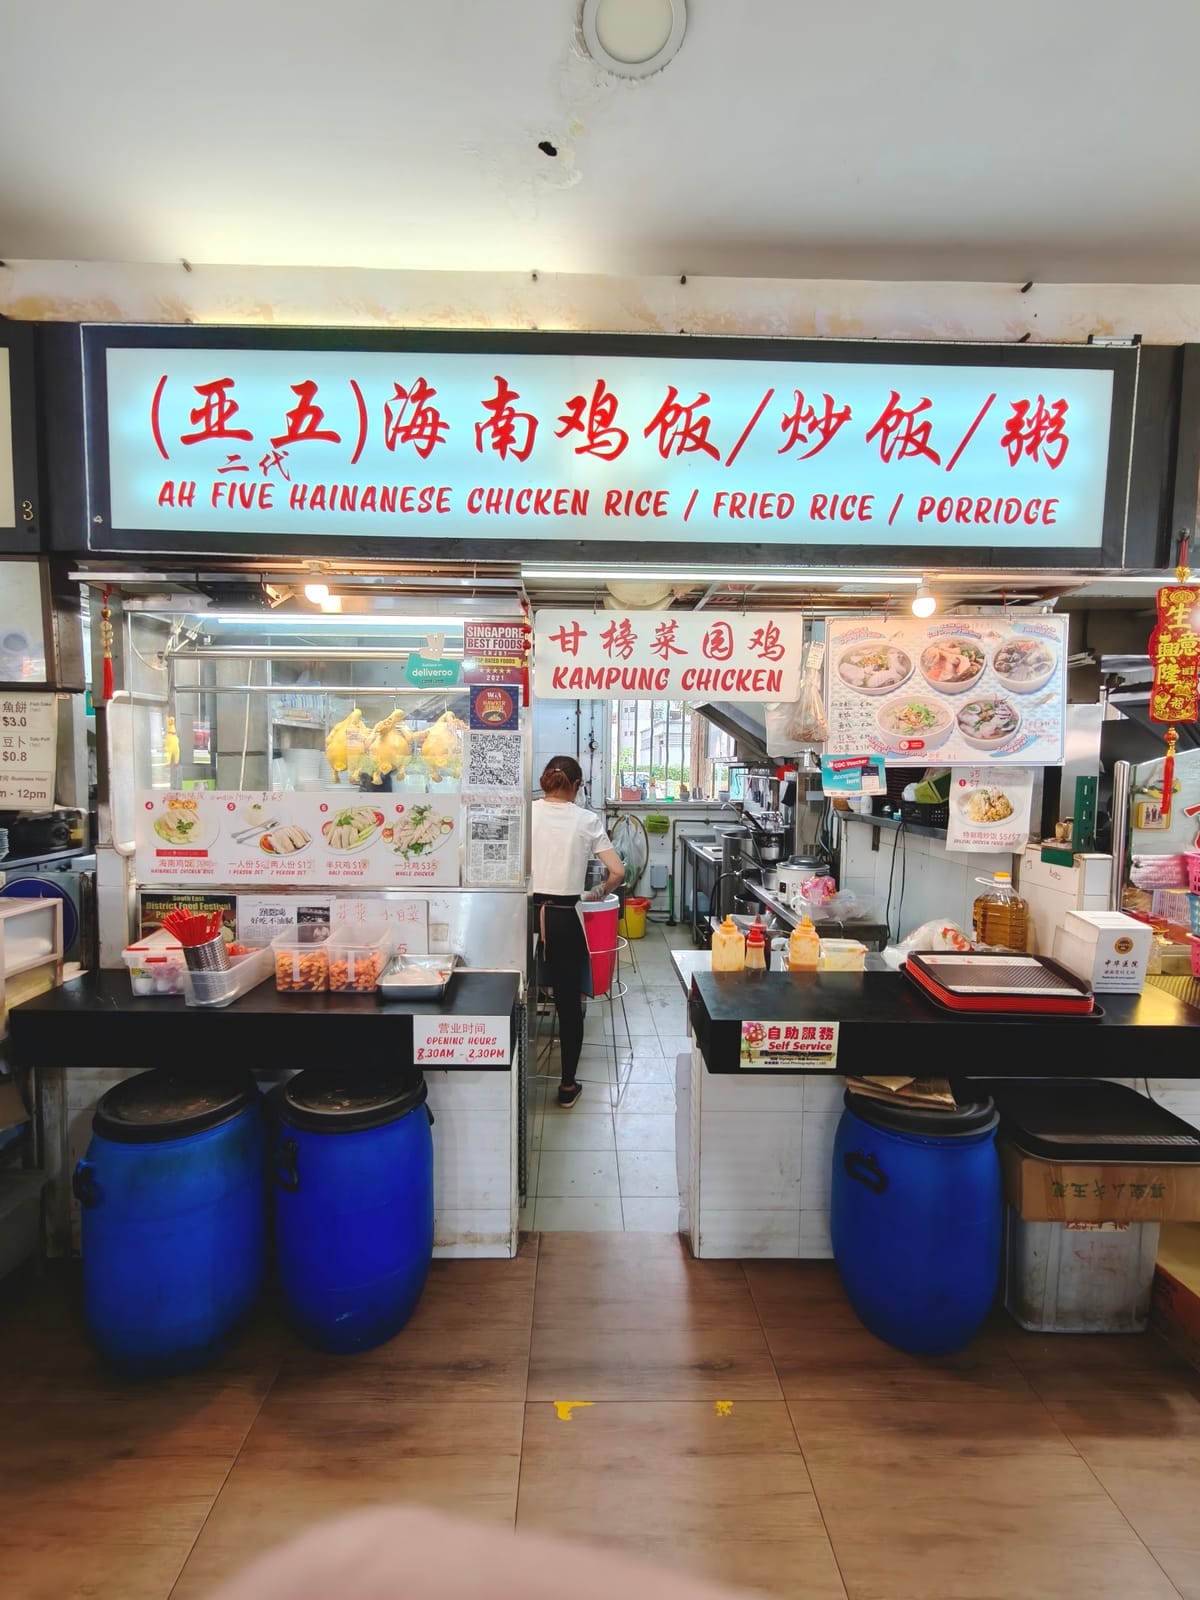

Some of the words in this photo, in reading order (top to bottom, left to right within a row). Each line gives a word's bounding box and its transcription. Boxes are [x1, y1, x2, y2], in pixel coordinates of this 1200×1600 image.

[216, 449, 292, 482] 二代
[158, 481, 196, 509] AH
[211, 481, 275, 511] FIVE
[289, 482, 452, 514] HAINANESE
[467, 487, 590, 517] CHICKEN
[603, 490, 670, 518] RICE
[713, 491, 795, 521] FRIED
[809, 493, 875, 523] RICE
[917, 496, 1059, 526] PORRIDGE
[22, 500, 34, 521] 3
[466, 625, 524, 639] SINGAPORE
[467, 638, 491, 649] BEST
[493, 639, 522, 650] FOODS
[411, 668, 453, 677] deliveroo
[552, 666, 670, 692] KAMPUNG
[681, 668, 784, 693] CHICKEN
[2, 716, 27, 727] $3.0
[2, 750, 28, 762] $0.8
[17, 788, 47, 800] 12pm
[146, 901, 177, 910] District
[179, 902, 198, 911] Food
[438, 1022, 486, 1035] 营业时间
[767, 1025, 834, 1041] 自助服務
[426, 1036, 464, 1045] OPENING
[467, 1037, 497, 1046] HOURS
[768, 1041, 791, 1051] Self
[792, 1041, 832, 1051] Service
